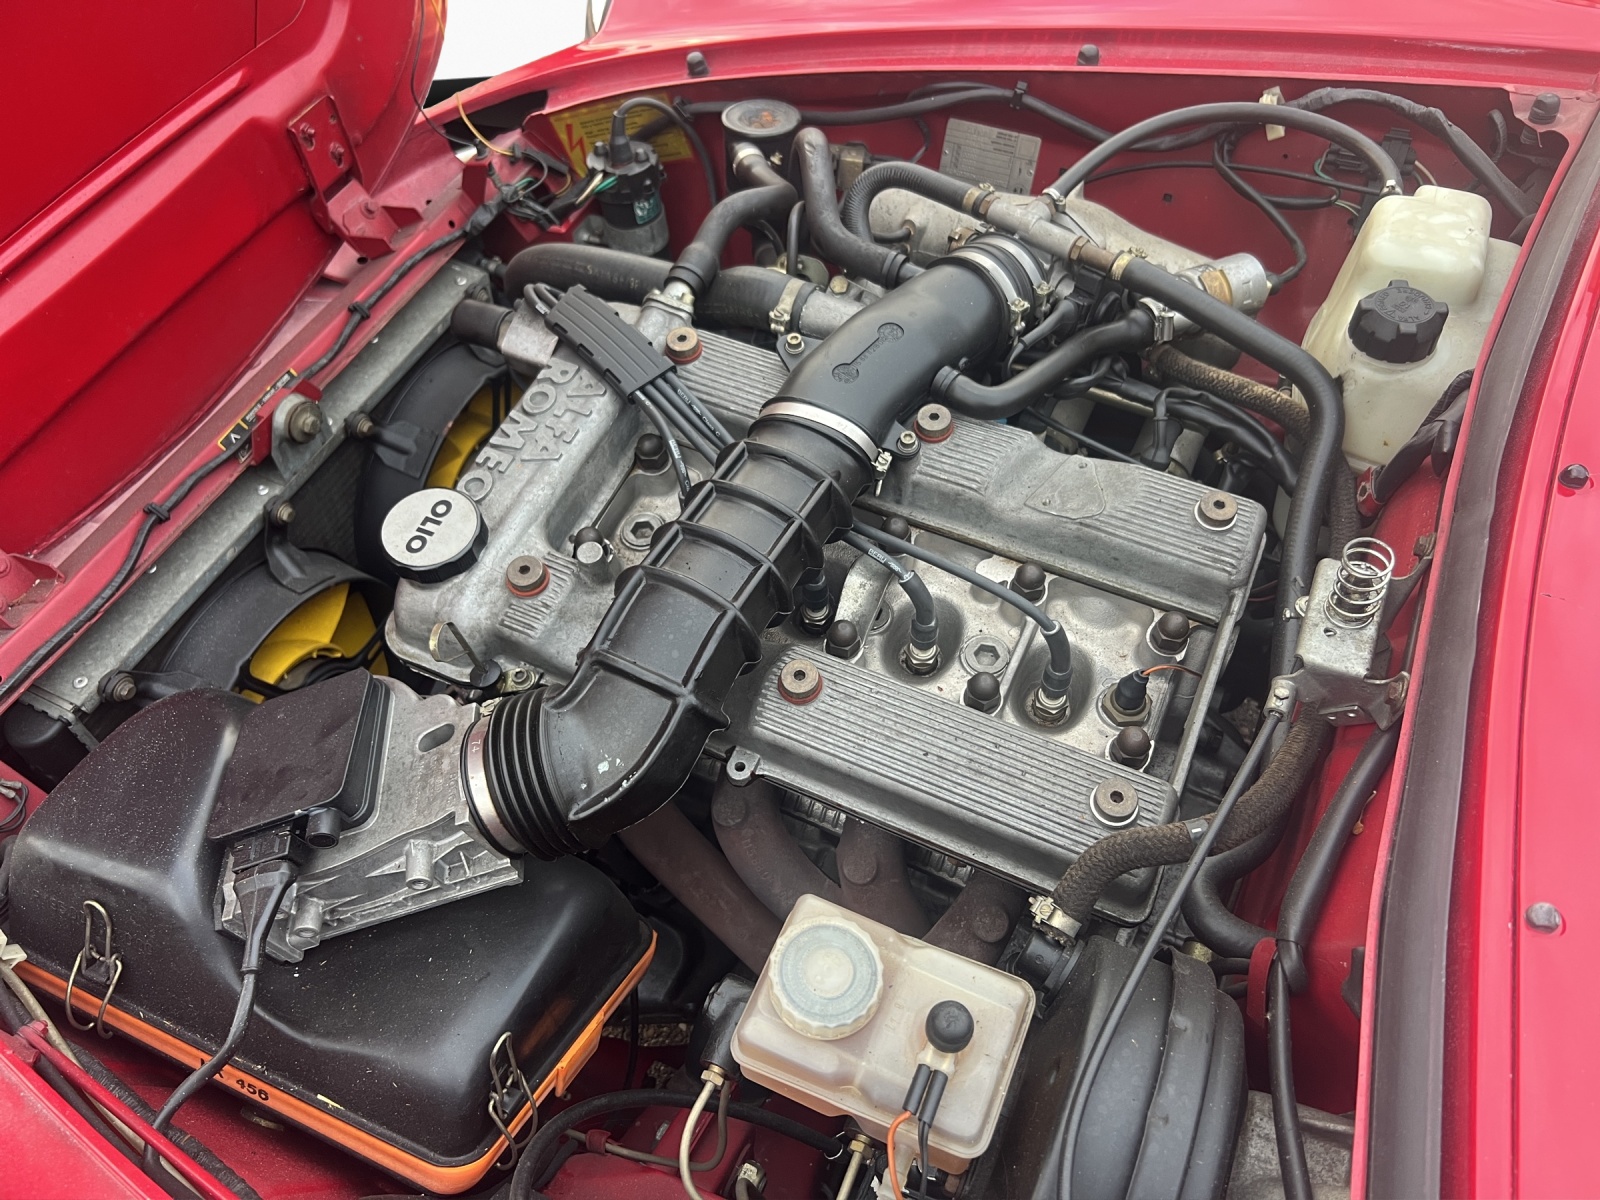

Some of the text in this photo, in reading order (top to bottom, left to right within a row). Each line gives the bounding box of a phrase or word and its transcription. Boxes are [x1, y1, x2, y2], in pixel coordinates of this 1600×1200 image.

[455, 357, 580, 501] ROMEO
[520, 369, 607, 462] ALFA
[405, 499, 453, 554] OLIO
[867, 547, 887, 564] BERU
[235, 1078, 269, 1101] 456
